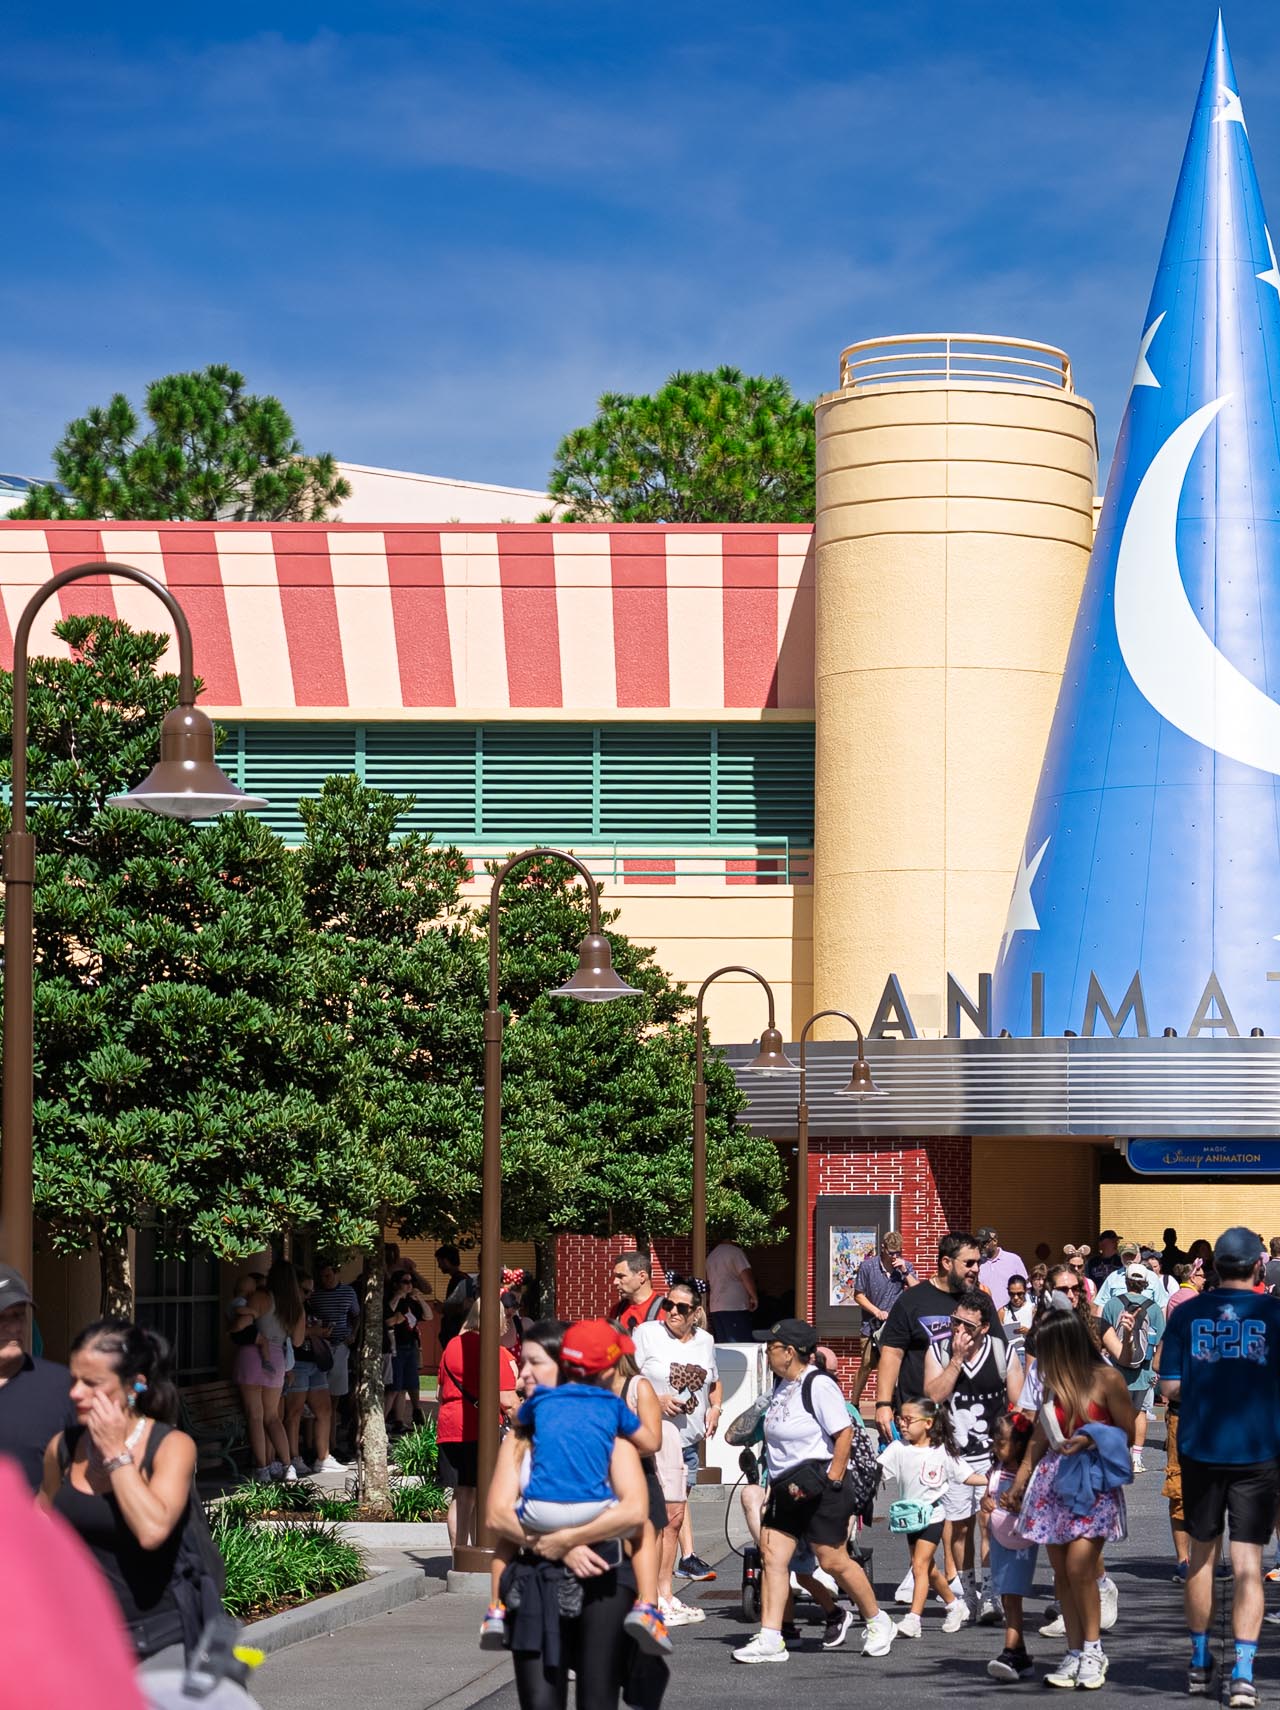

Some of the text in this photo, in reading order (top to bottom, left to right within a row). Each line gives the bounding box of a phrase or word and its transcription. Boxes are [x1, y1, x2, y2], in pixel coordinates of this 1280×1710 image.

[1162, 1150, 1261, 1168] Disney ANIMATION
[1191, 1318, 1266, 1358] 626
